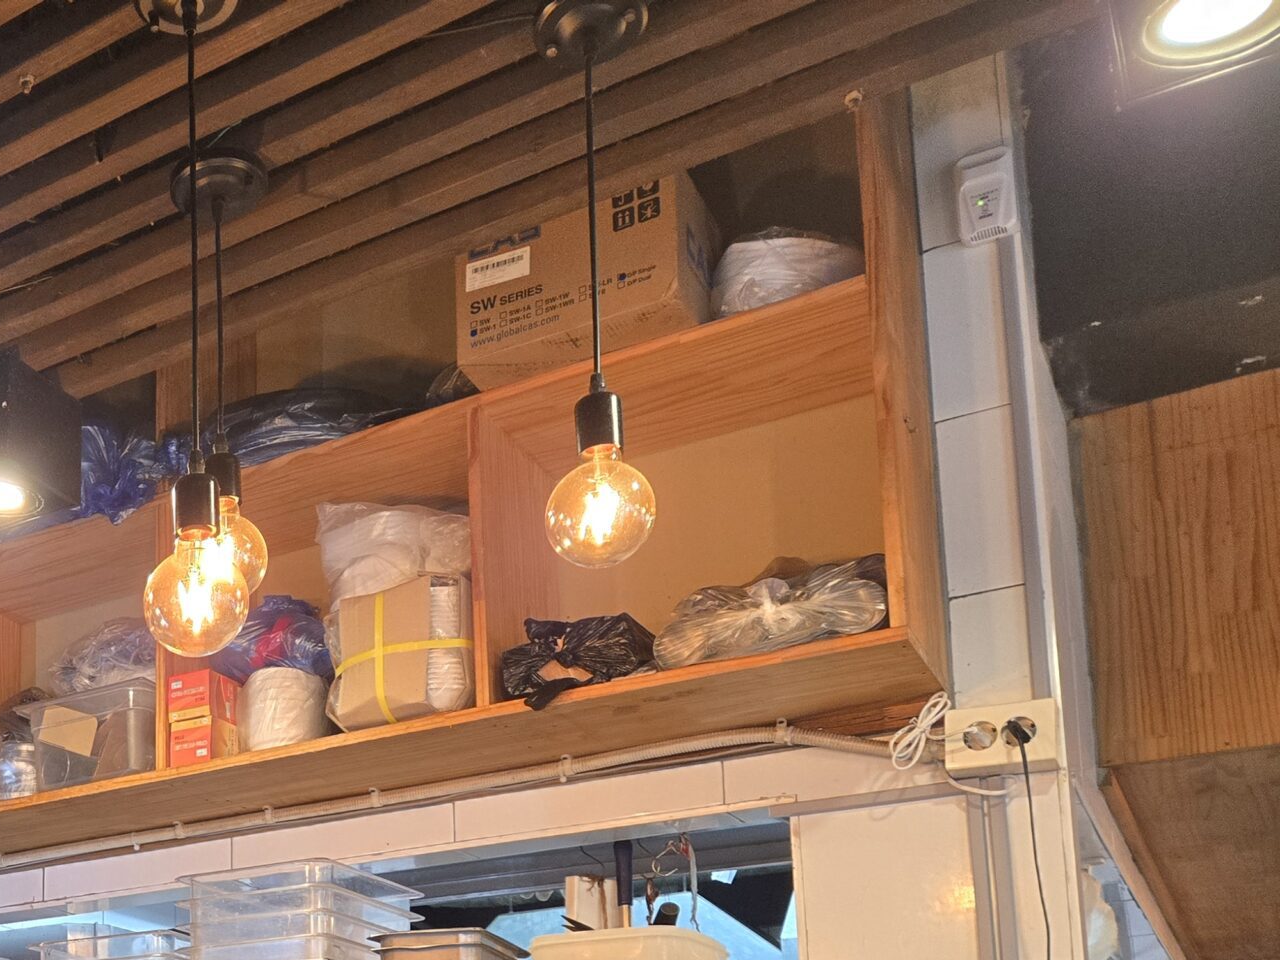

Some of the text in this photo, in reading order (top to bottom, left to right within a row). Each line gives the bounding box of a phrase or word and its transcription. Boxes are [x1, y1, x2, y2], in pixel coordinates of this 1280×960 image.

[470, 284, 543, 315] SW SERIES
[470, 314, 561, 349] www.globalcas.com
